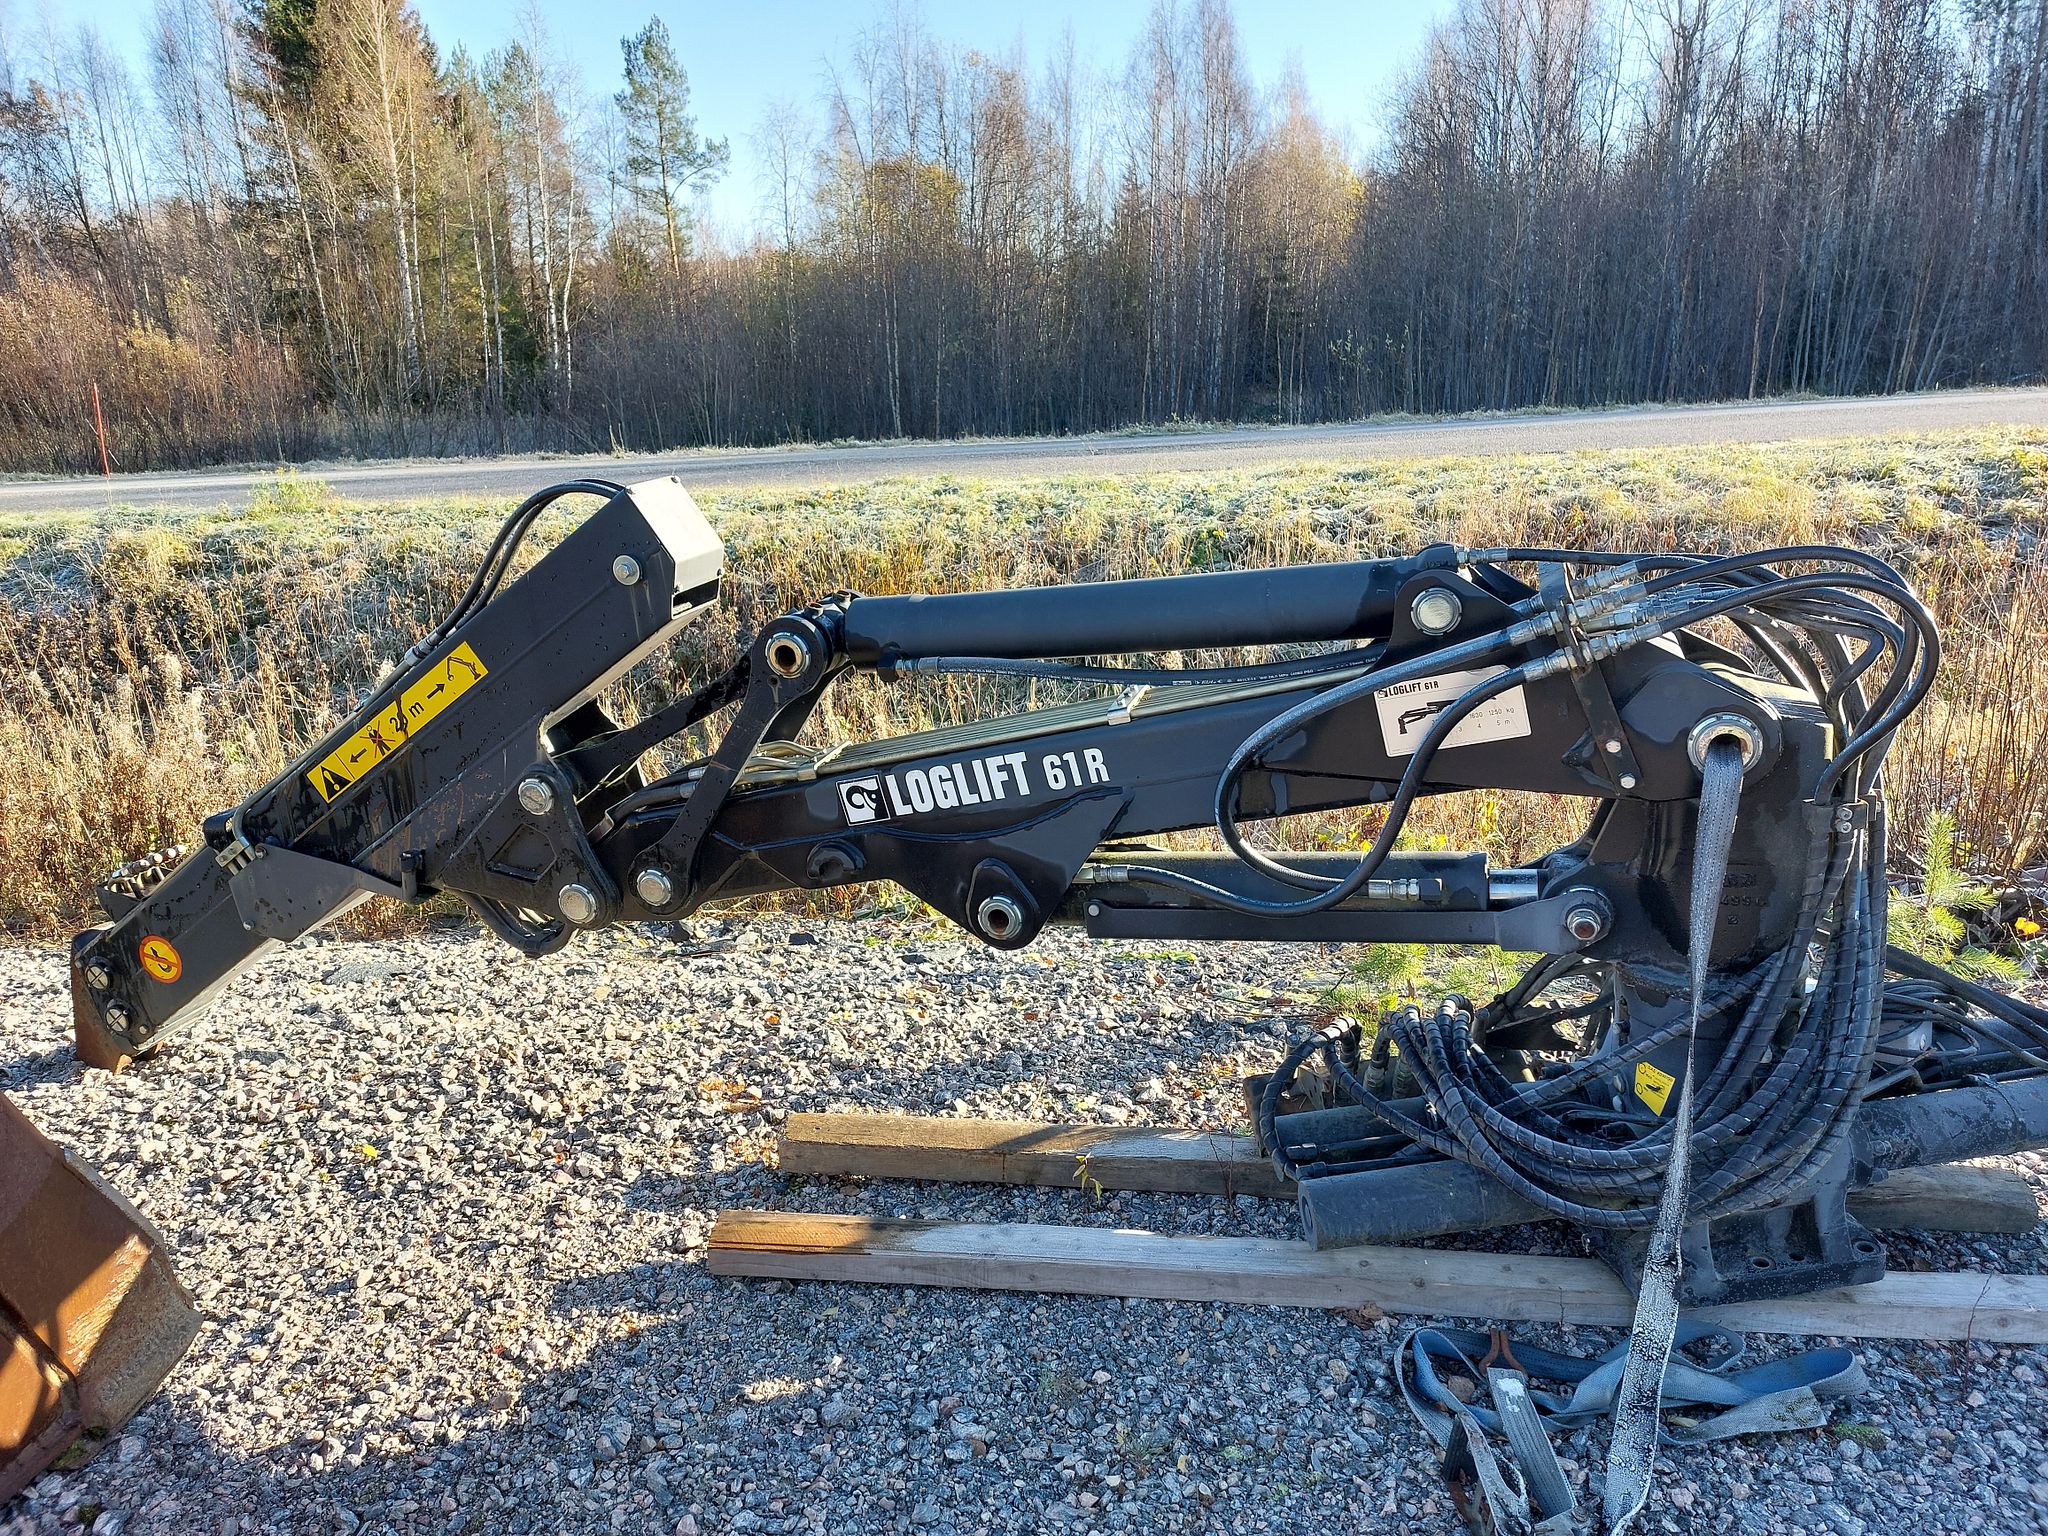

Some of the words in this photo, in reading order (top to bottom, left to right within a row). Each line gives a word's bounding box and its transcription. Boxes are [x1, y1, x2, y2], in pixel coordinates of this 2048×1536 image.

[1388, 682, 1422, 697] LOGLIFT
[408, 701, 425, 718] m
[1488, 707, 1503, 716] 1250
[885, 752, 1031, 816] LOGLIFT
